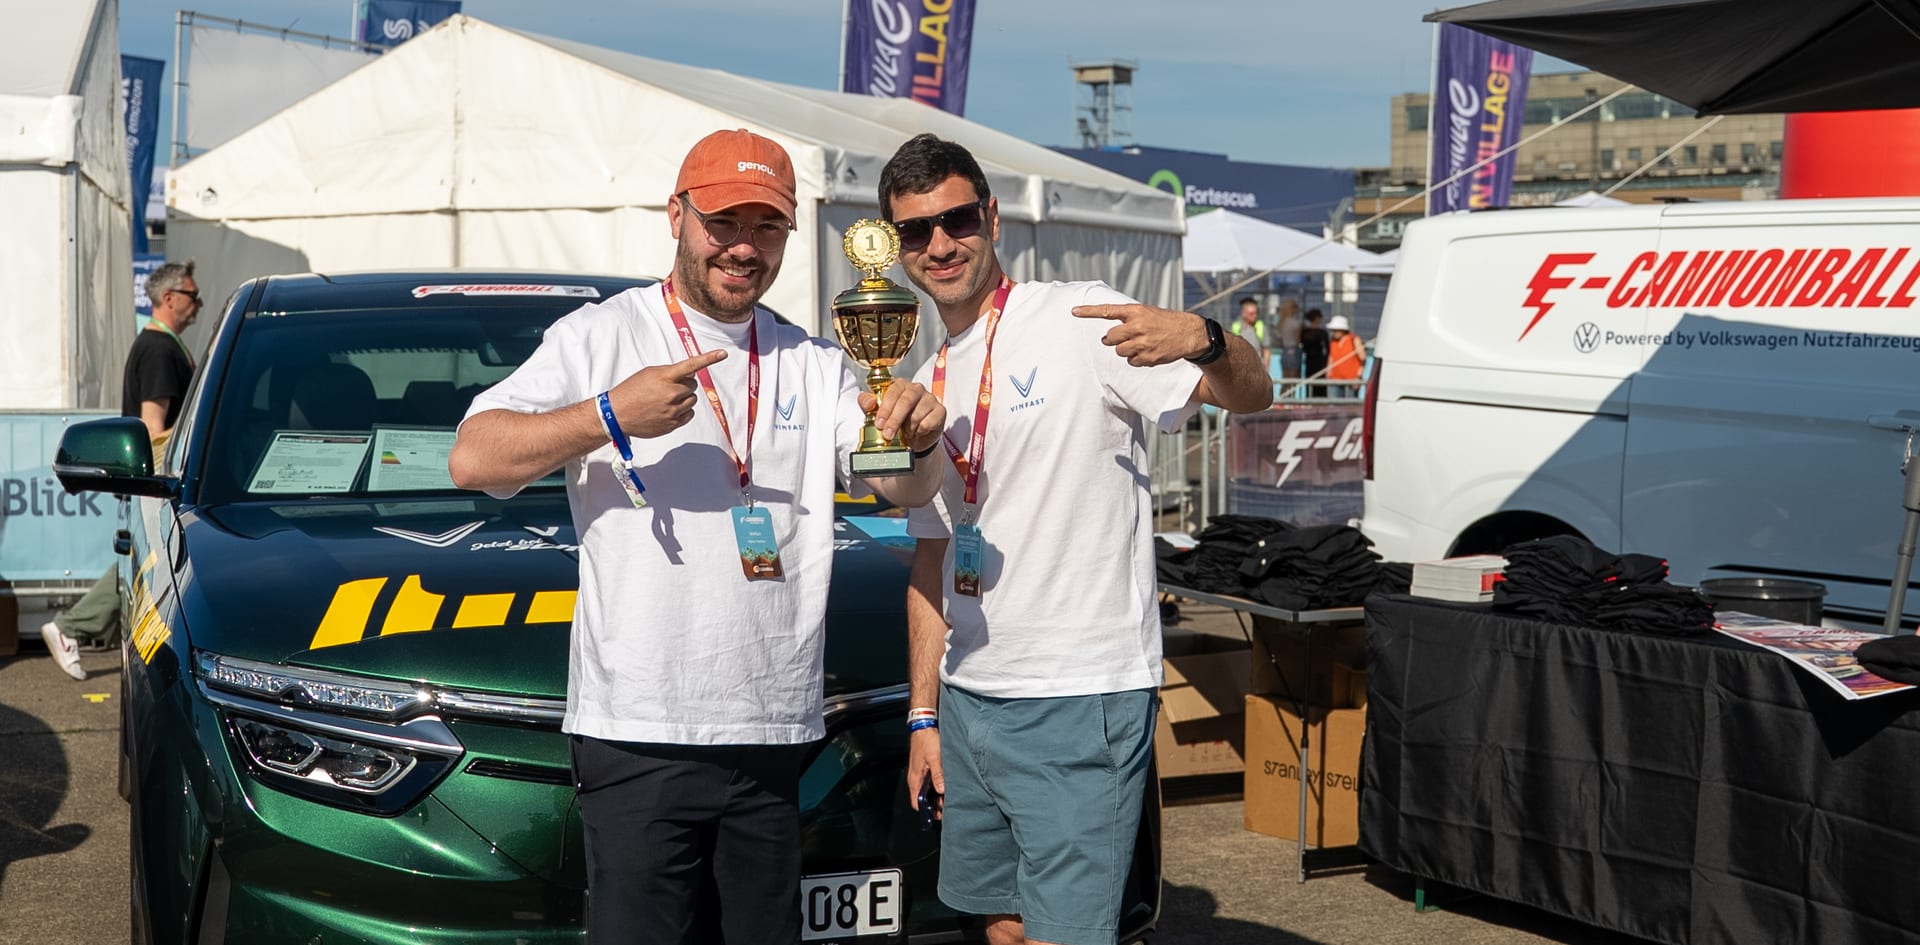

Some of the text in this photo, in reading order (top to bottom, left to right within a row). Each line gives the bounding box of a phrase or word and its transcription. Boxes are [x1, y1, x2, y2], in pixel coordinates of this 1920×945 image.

[912, 0, 953, 109] ILLA
[1473, 49, 1515, 179] VILLAGE
[866, 234, 877, 251] 1
[1518, 247, 1920, 342] E-CANNONBALL
[1605, 331, 1673, 346] Powered
[1676, 331, 1695, 349] by
[1697, 331, 1798, 350] Volkswagen
[1010, 398, 1044, 412] VINFAST
[3, 476, 102, 517] Blick
